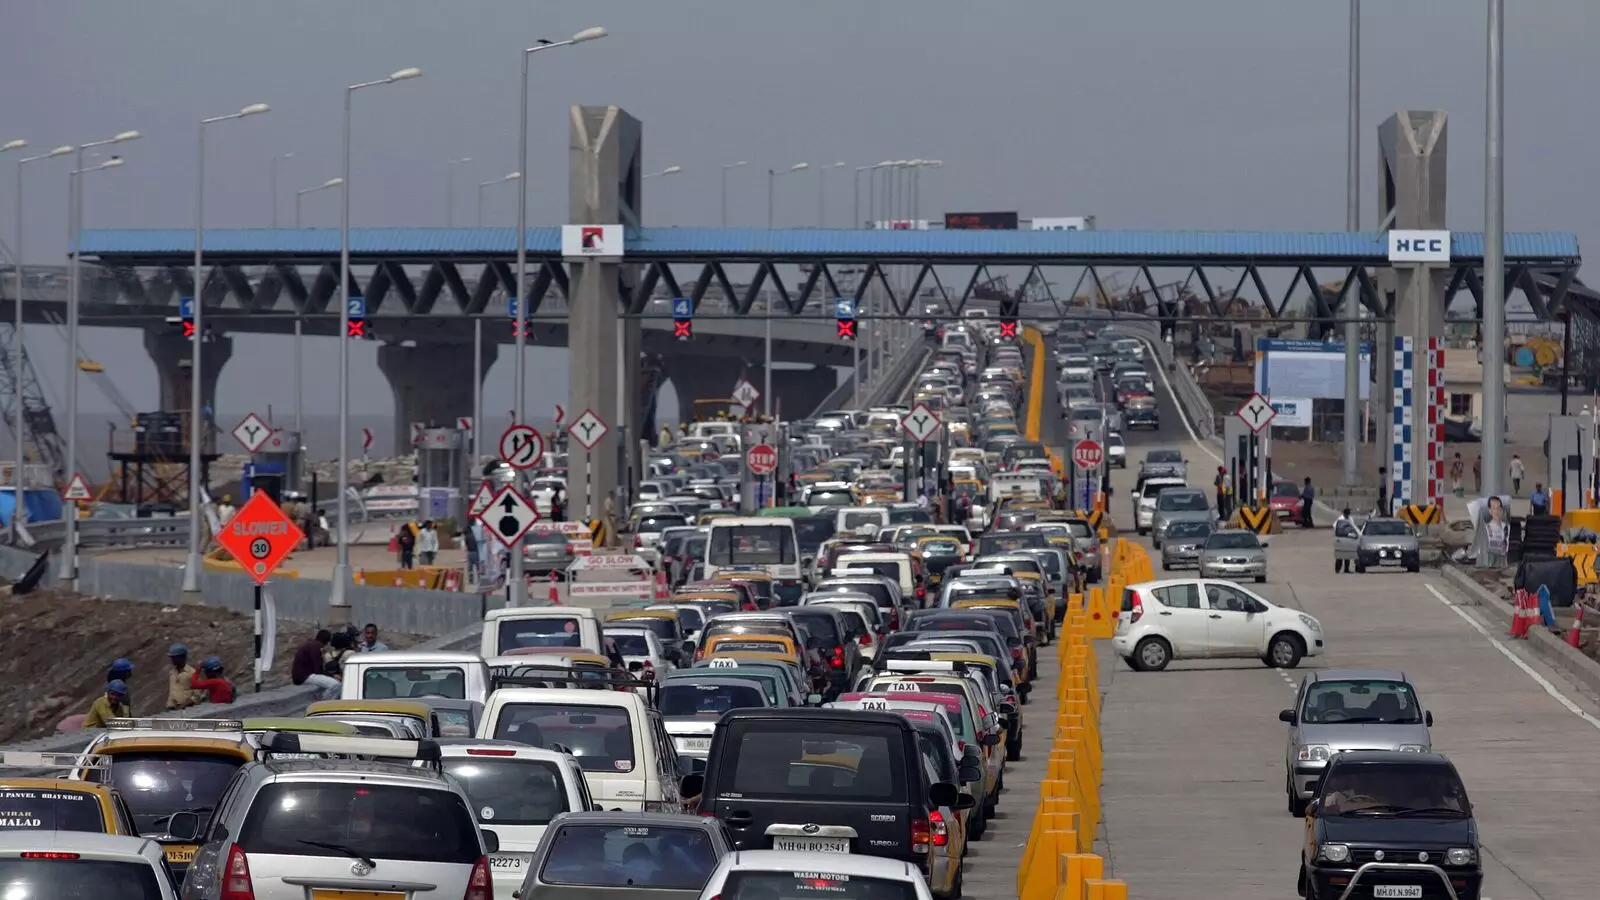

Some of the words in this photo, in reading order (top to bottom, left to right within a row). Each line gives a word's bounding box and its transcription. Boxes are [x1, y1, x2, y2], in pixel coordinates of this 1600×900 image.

[1396, 239, 1442, 252] HCC
[349, 300, 362, 314] 2
[676, 300, 689, 314] 4
[838, 300, 852, 314] 5
[749, 452, 775, 465] STOP
[1075, 448, 1101, 460] STOP
[552, 523, 579, 532] SLOW
[253, 543, 267, 553] 30
[588, 556, 603, 564] GO
[605, 555, 634, 564] SLOW
[893, 683, 915, 691] TAXI
[862, 702, 886, 710] TAXI
[779, 842, 795, 851] MH
[796, 843, 807, 851] 04
[824, 843, 845, 852] 2541
[490, 857, 521, 868] R2273
[793, 871, 819, 879] WASAN
[820, 873, 850, 881] MOTORS
